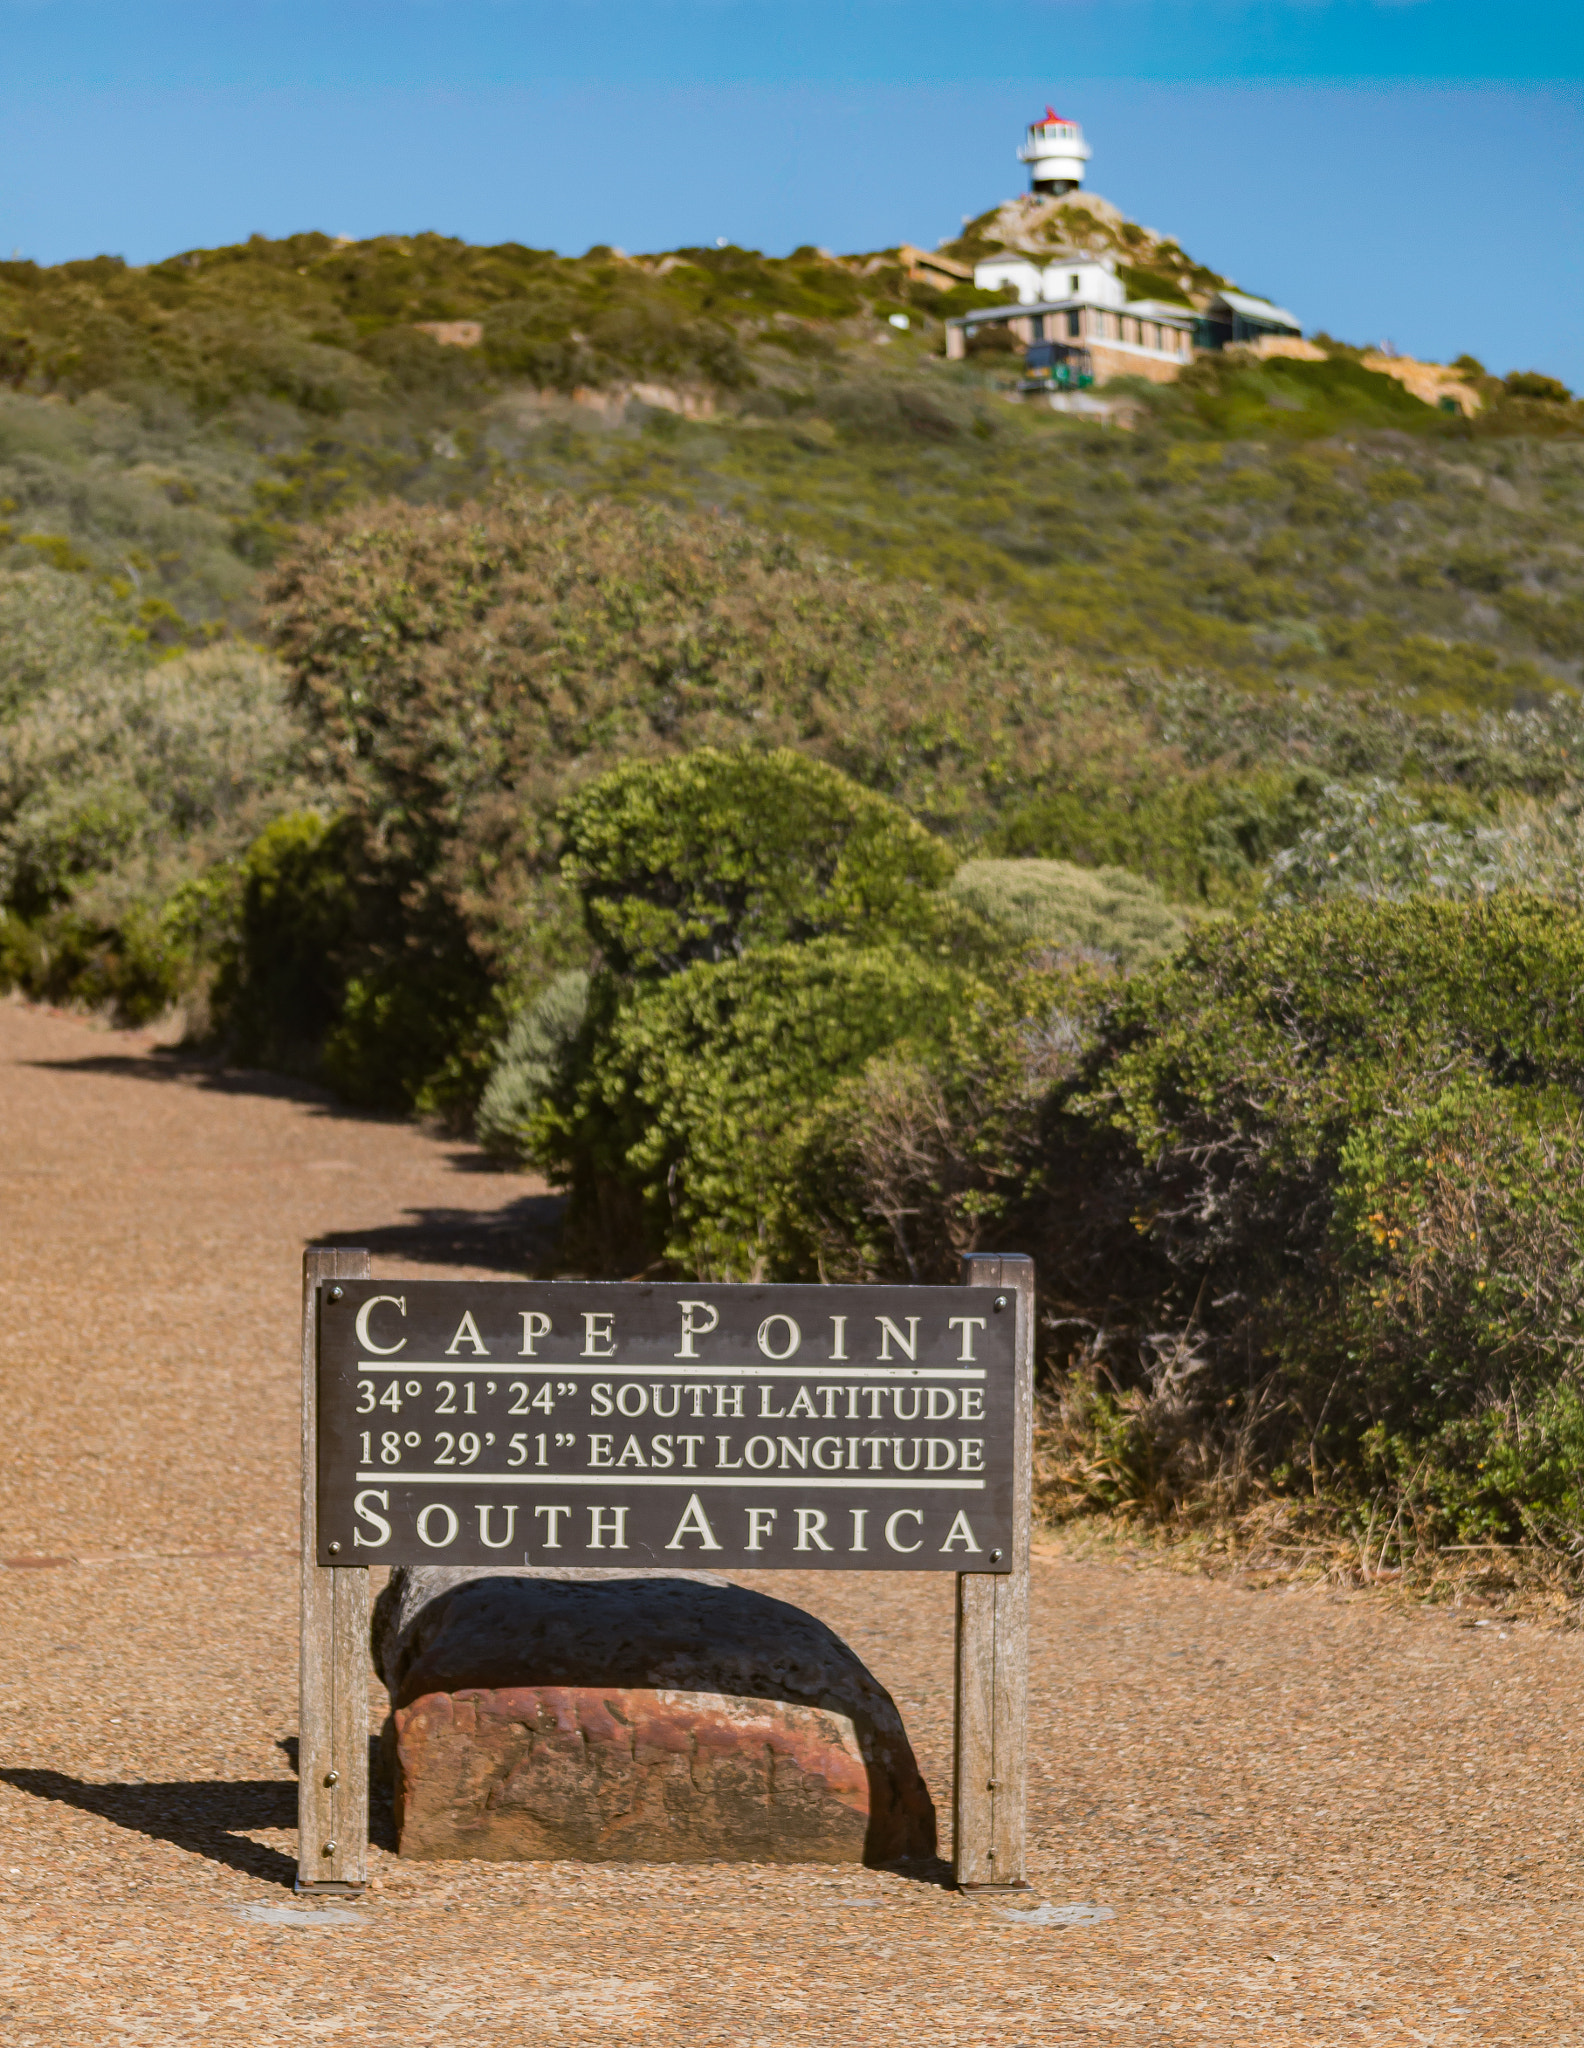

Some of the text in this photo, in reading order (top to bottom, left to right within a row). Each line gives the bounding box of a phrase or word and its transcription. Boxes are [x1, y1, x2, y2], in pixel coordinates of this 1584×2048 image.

[355, 1295, 987, 1362] CAPE POINT
[590, 1382, 746, 1418] SOUTH
[756, 1384, 987, 1421] LATITUDE
[586, 1433, 705, 1469] EAST
[714, 1435, 986, 1472] LONGITUDE
[353, 1489, 984, 1554] SOUTH AFRICA
